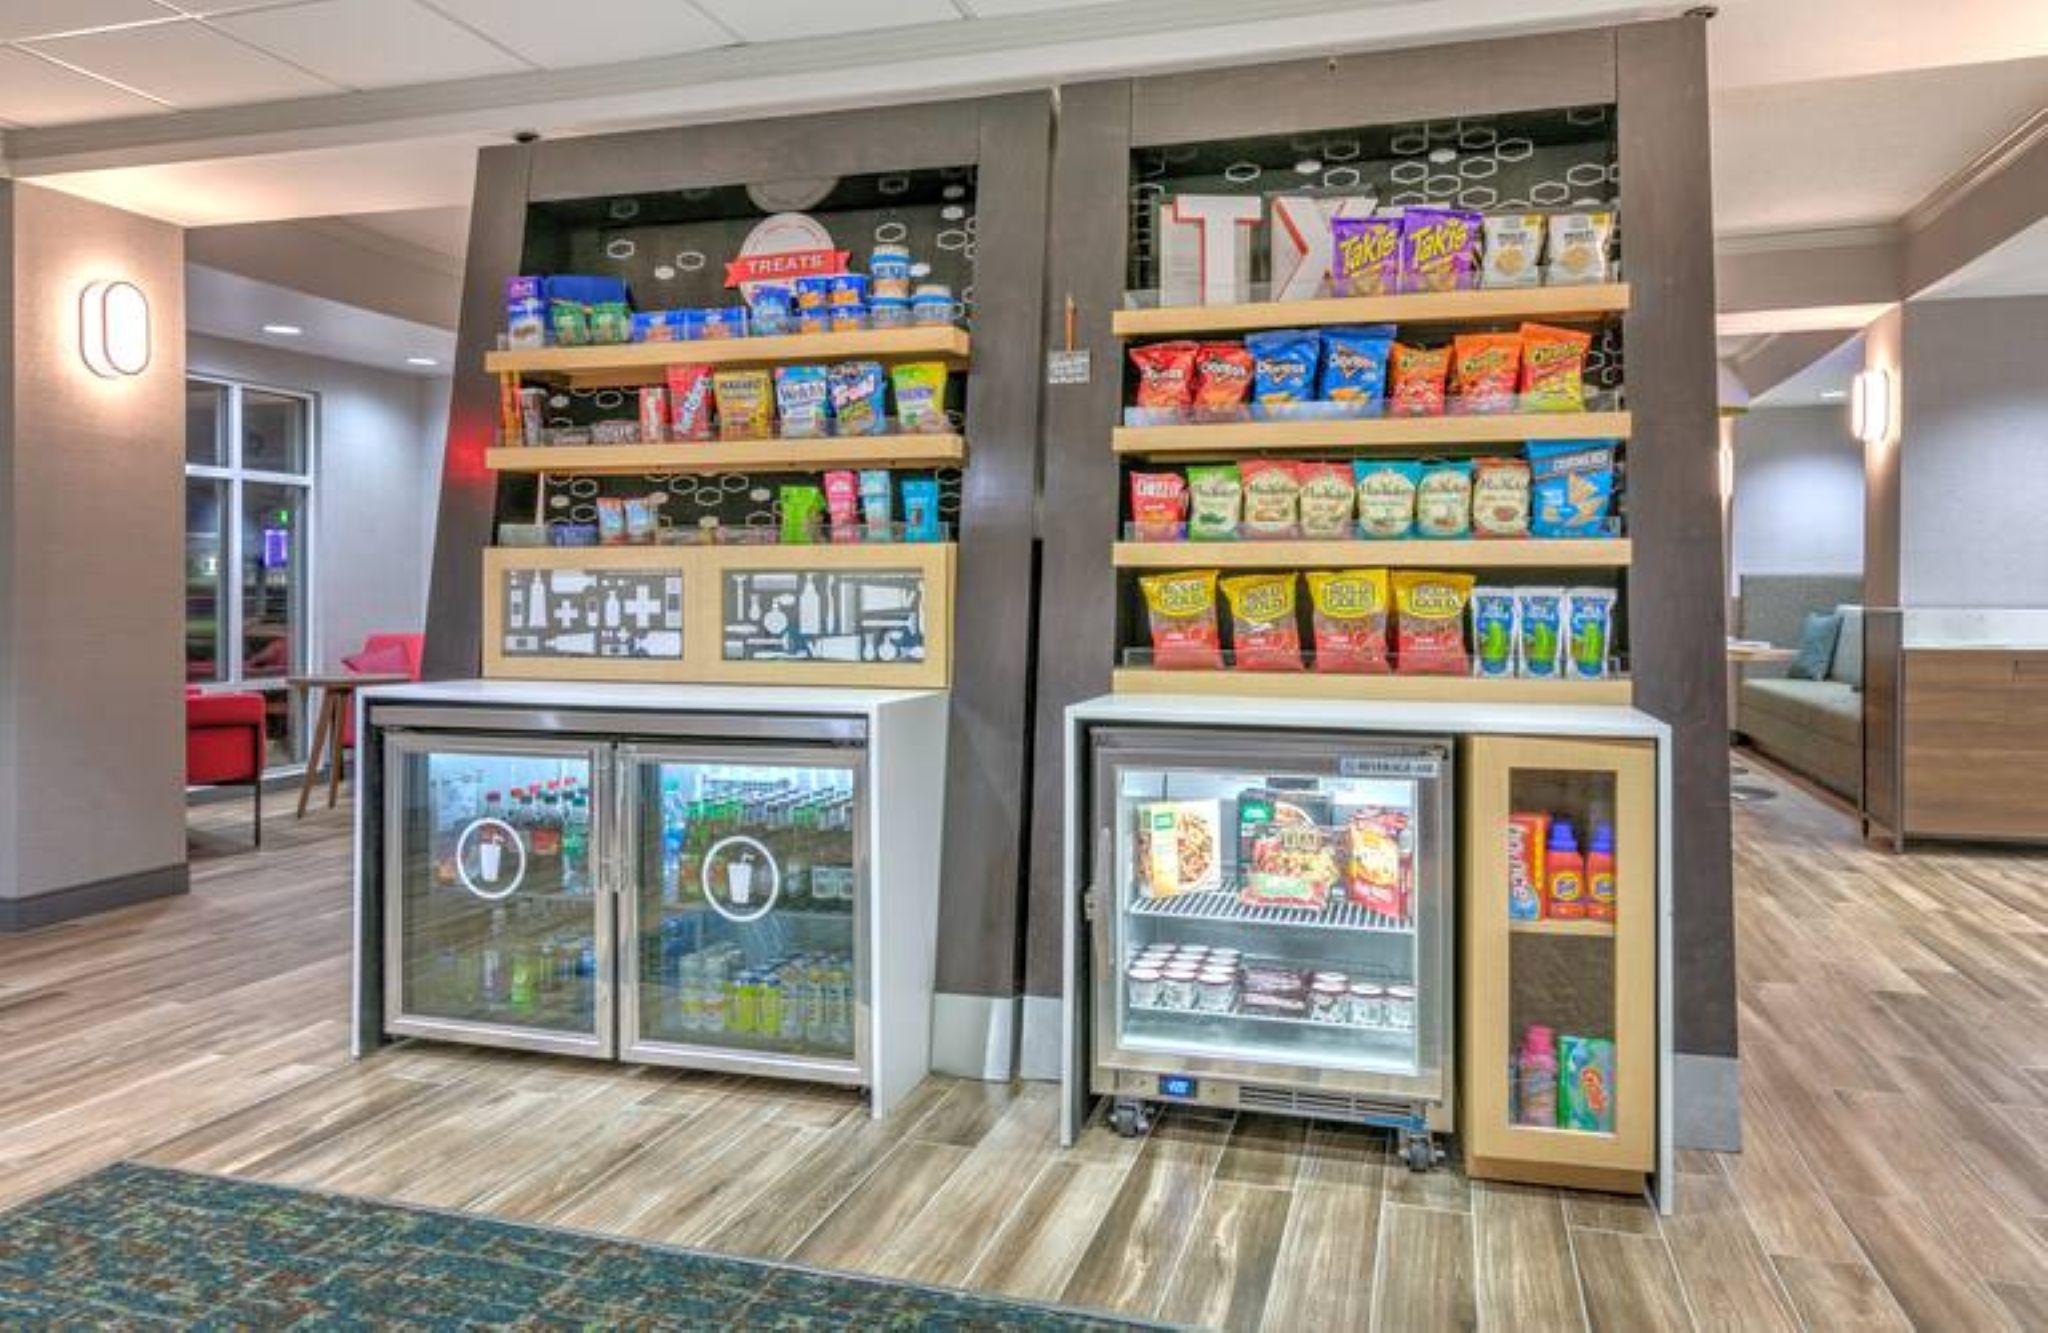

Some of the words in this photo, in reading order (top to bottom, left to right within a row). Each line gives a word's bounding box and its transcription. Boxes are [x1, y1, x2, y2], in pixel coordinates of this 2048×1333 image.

[747, 255, 824, 273] TREATS
[1340, 225, 1398, 274] Takis
[1409, 218, 1468, 269] Takis
